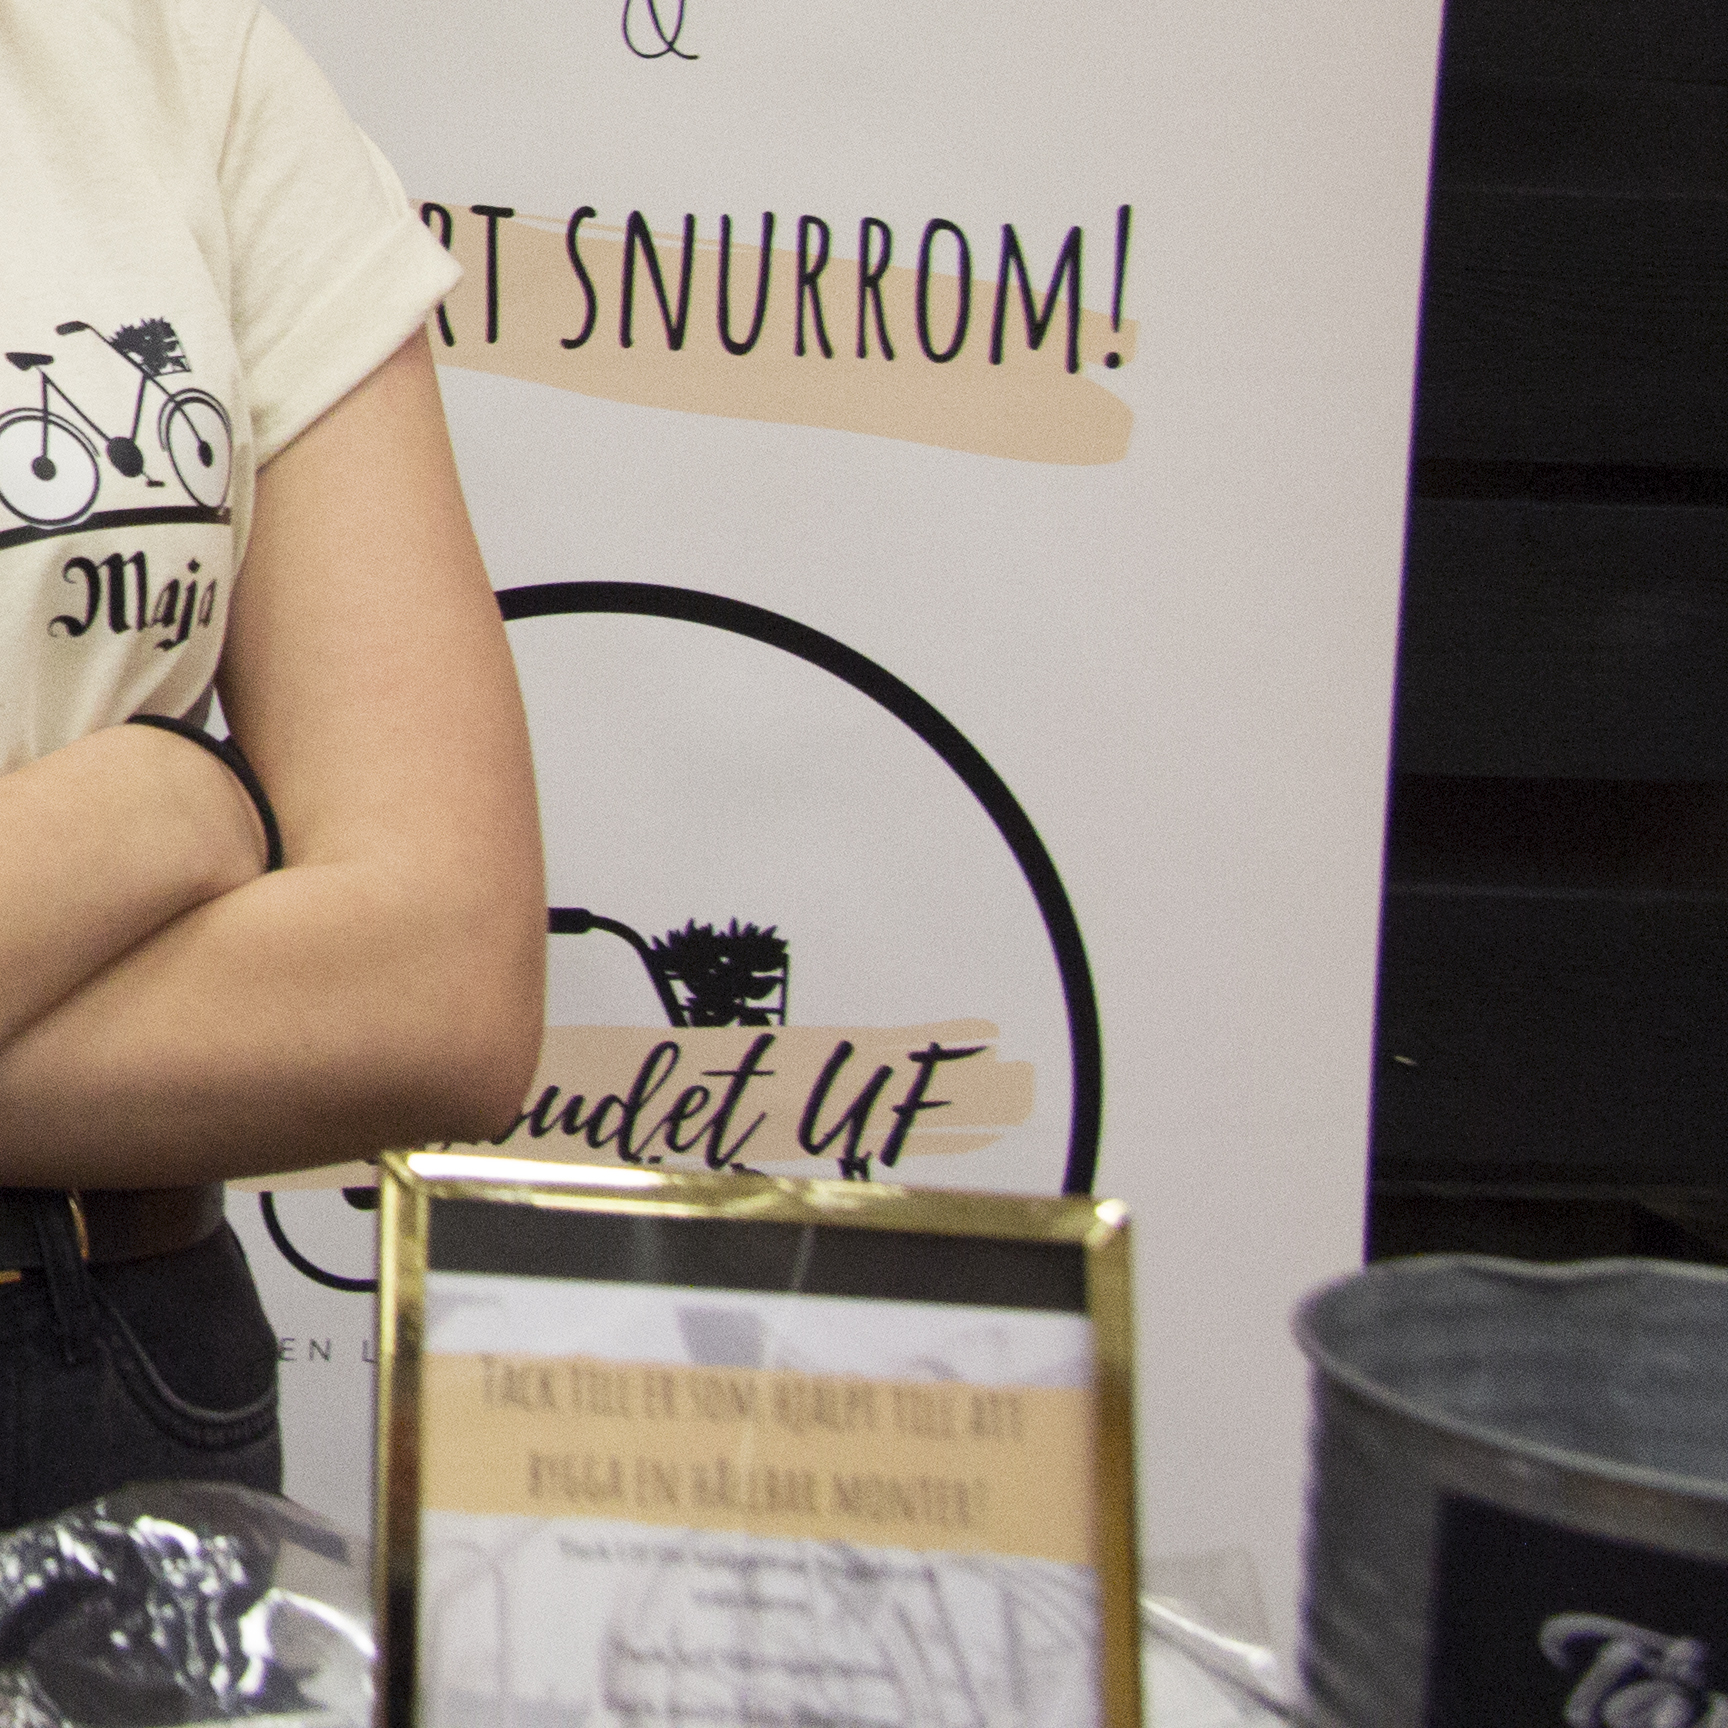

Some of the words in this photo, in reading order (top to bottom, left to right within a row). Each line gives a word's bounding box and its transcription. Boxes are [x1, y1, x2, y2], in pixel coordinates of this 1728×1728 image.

[560, 203, 1133, 375] SNURROM!
[47, 550, 218, 652] Maja
[796, 1038, 988, 1169] UF
